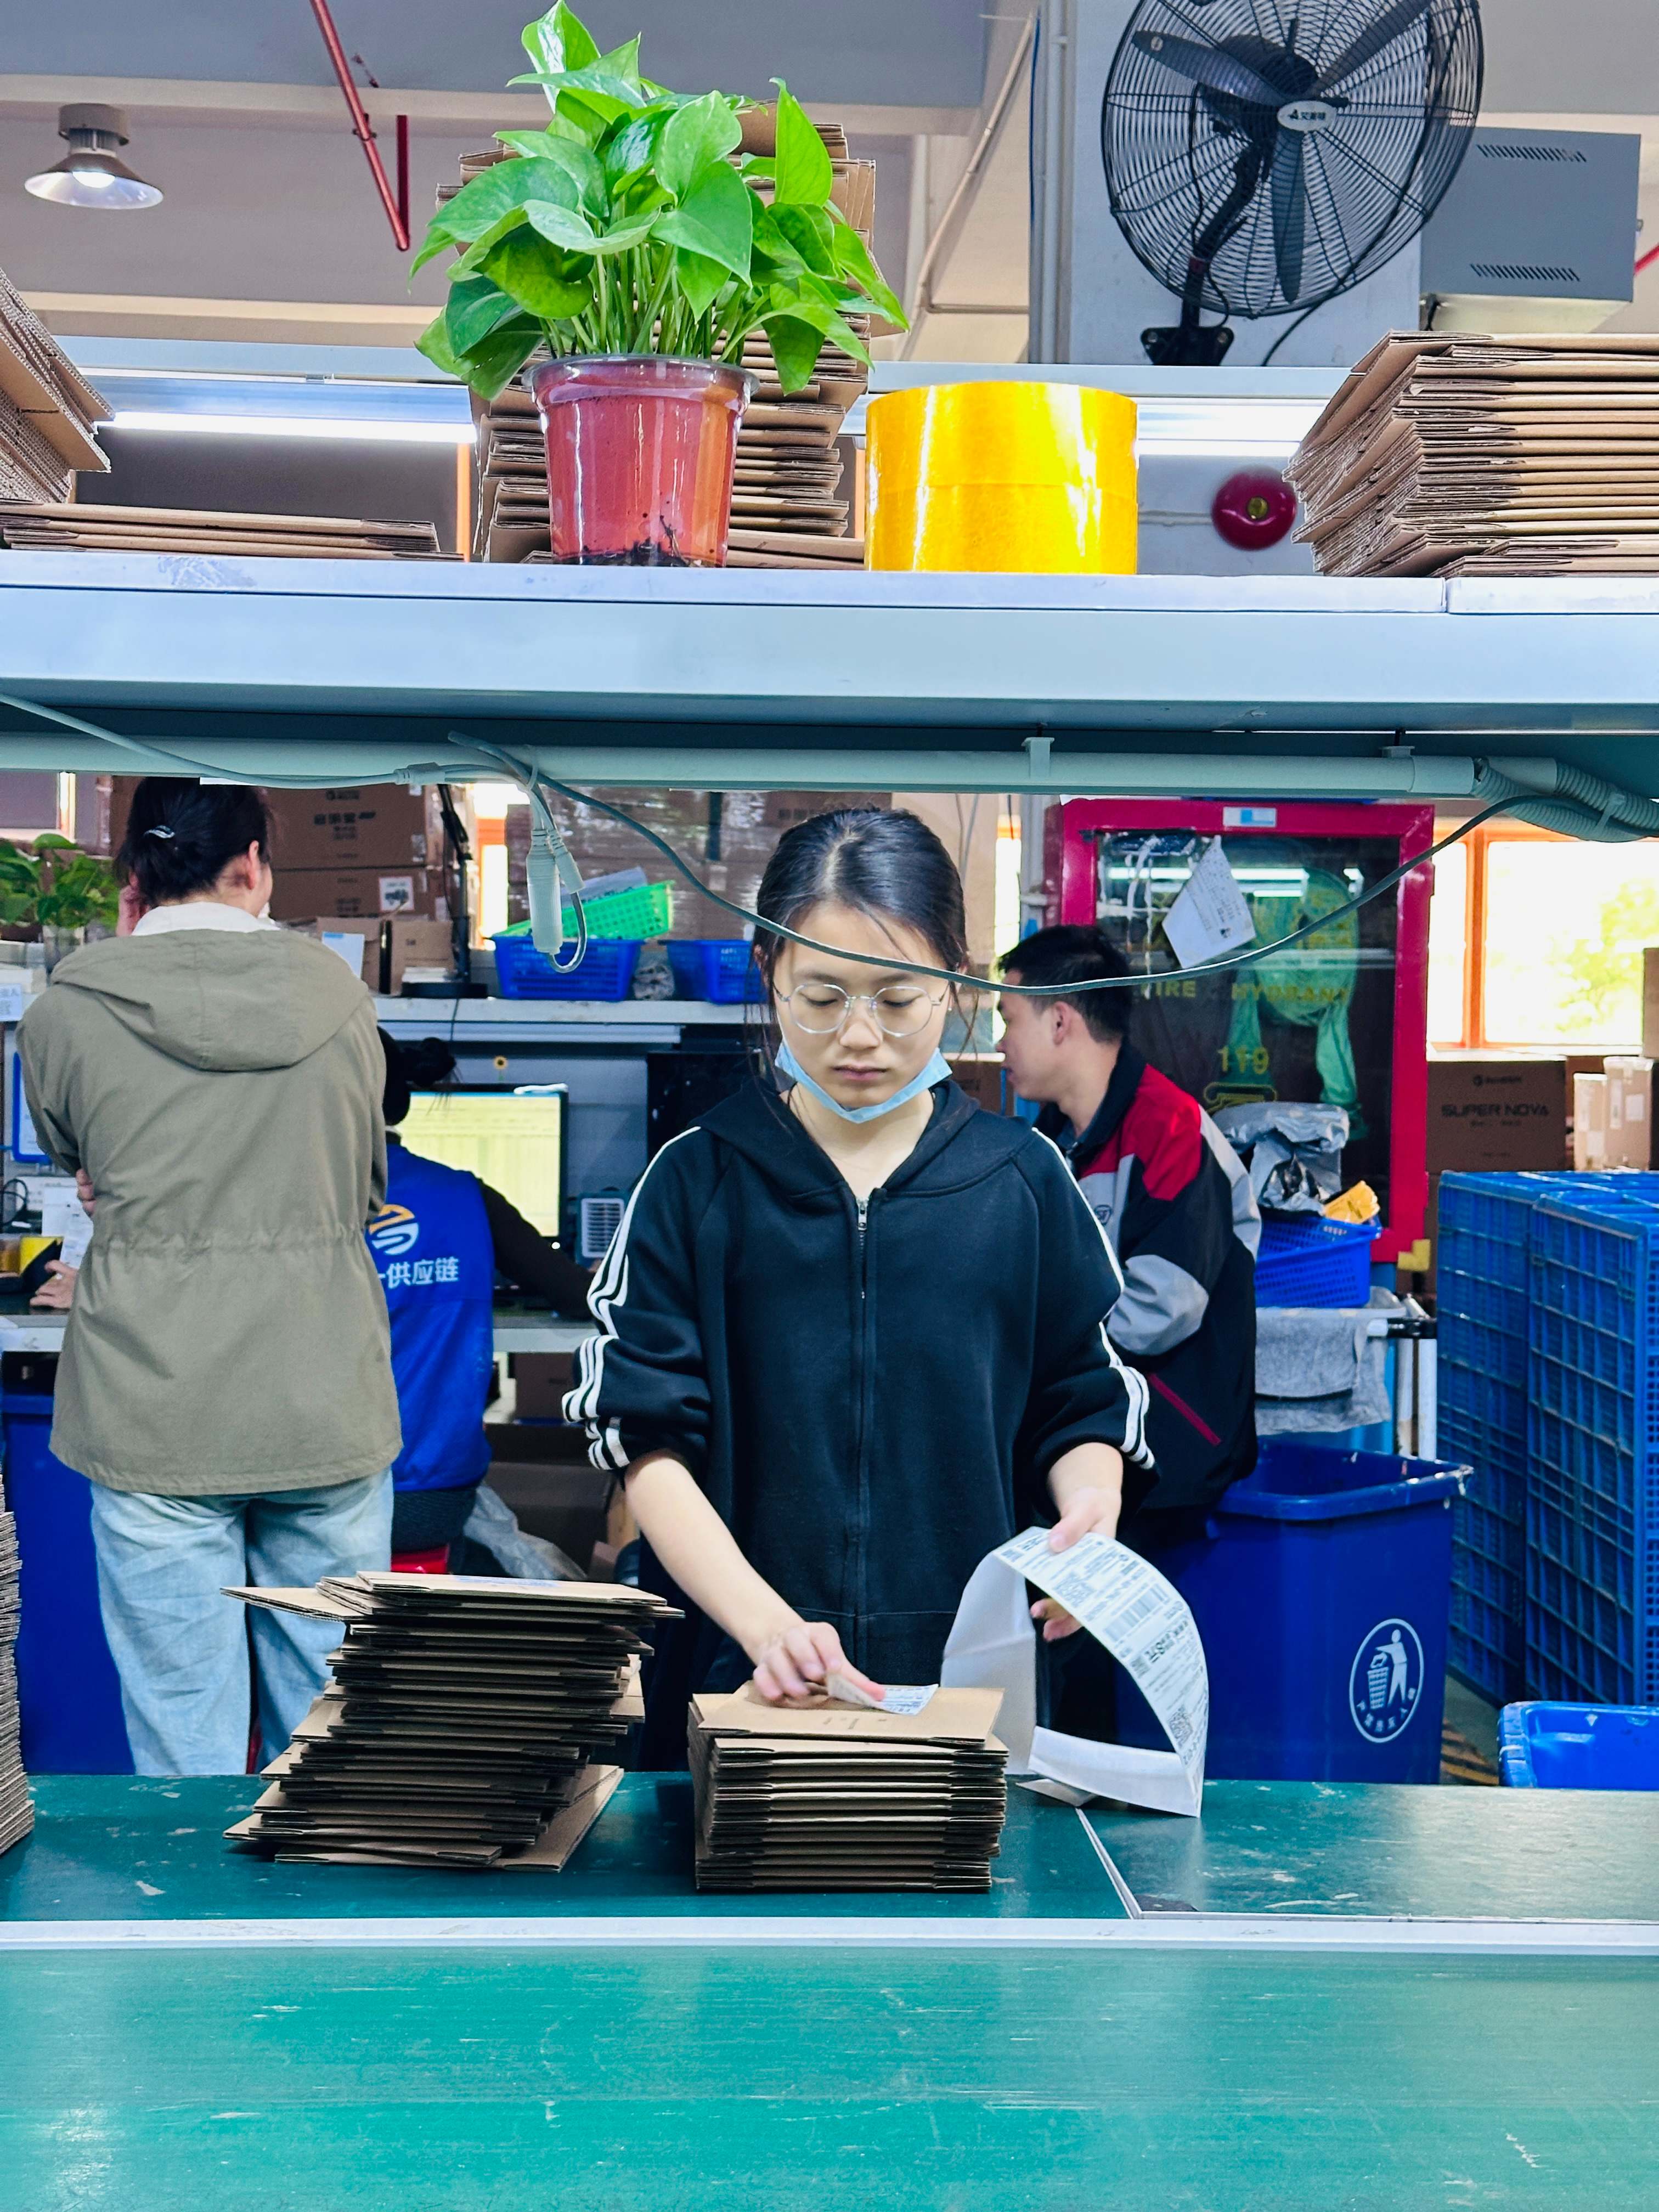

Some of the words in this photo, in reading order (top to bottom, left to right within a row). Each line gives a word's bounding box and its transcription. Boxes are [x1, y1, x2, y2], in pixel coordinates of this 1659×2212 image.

[1218, 1046, 1269, 1074] 119
[1441, 1103, 1500, 1118] SUPER
[1505, 1103, 1550, 1117] NOVA
